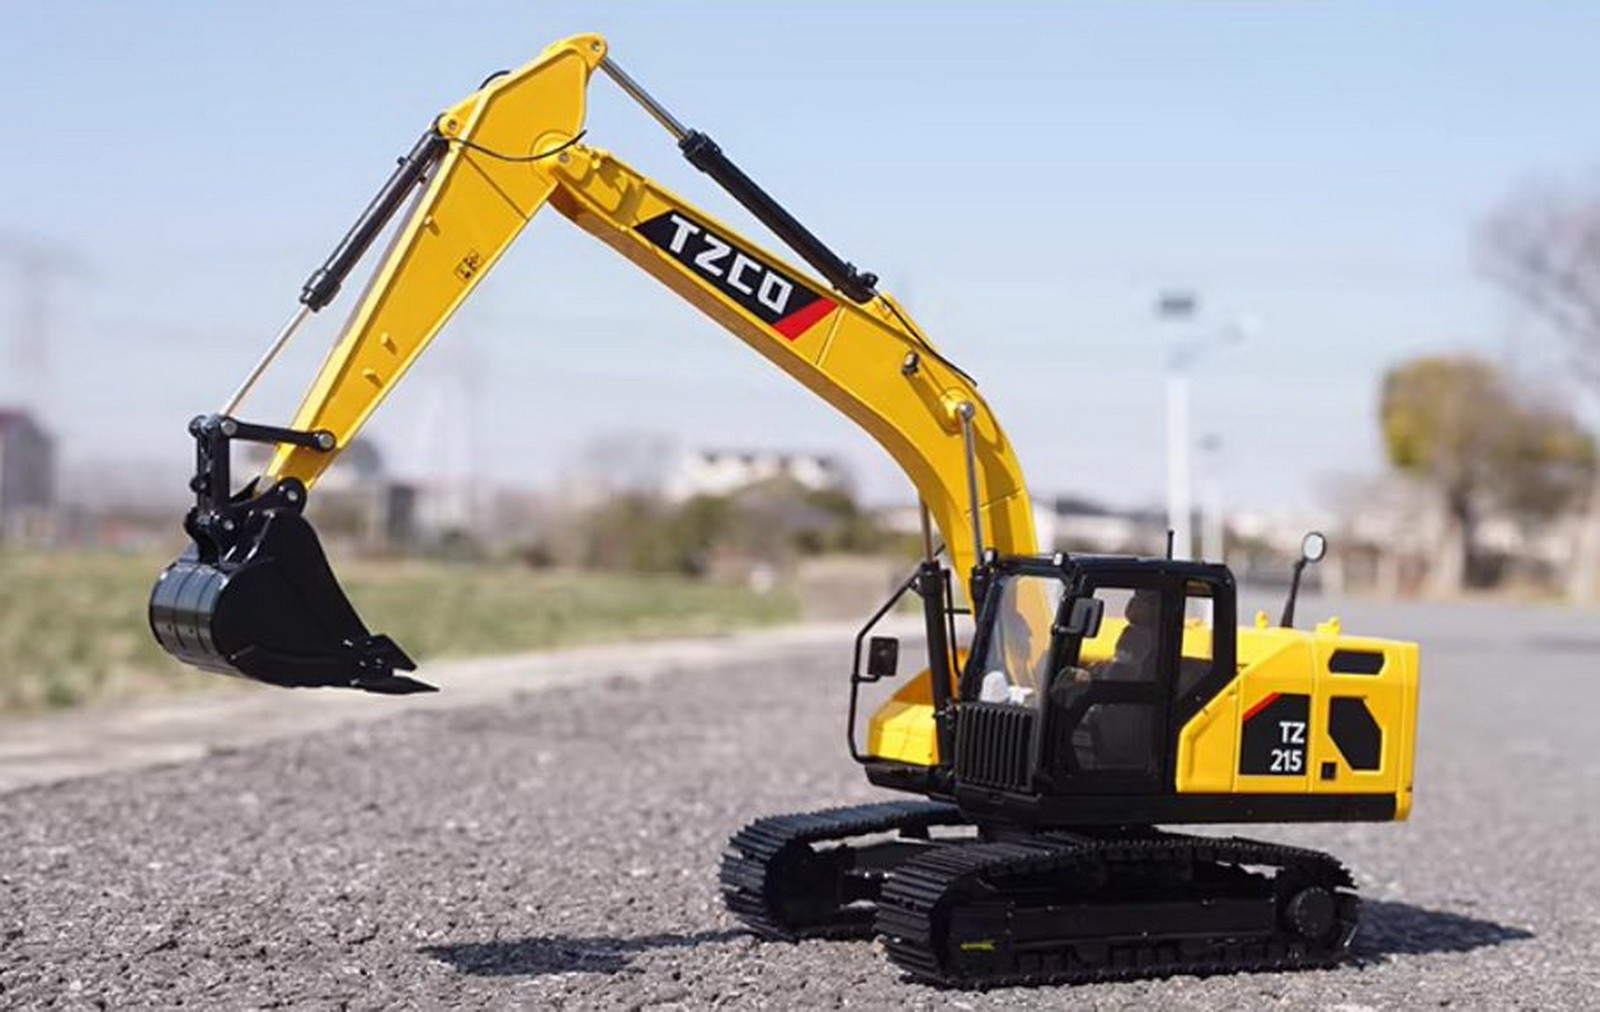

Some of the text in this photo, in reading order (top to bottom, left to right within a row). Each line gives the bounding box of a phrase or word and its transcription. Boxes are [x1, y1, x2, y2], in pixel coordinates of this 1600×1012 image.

[669, 214, 794, 314] TZCO
[1279, 721, 1306, 743] TZ
[1270, 749, 1302, 772] 215
